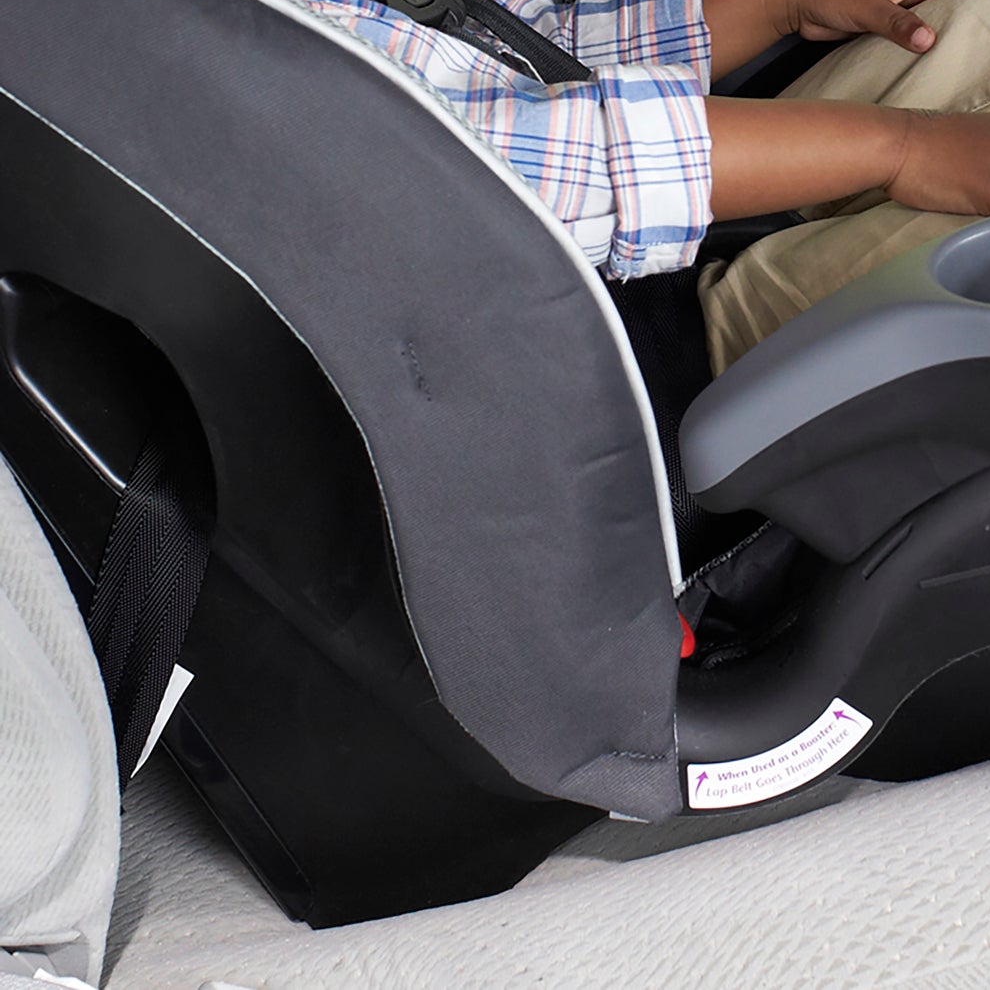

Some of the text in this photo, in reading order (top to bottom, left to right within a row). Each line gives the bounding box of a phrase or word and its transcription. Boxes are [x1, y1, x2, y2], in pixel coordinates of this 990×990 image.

[706, 787, 728, 799] Lap
[731, 779, 752, 795] Belt
[756, 773, 783, 788] Goes
[785, 747, 828, 776] Through
[828, 729, 849, 750] Here
[717, 768, 748, 782] When
[751, 758, 775, 774] Used
[778, 753, 789, 764] as
[791, 749, 799, 757] a
